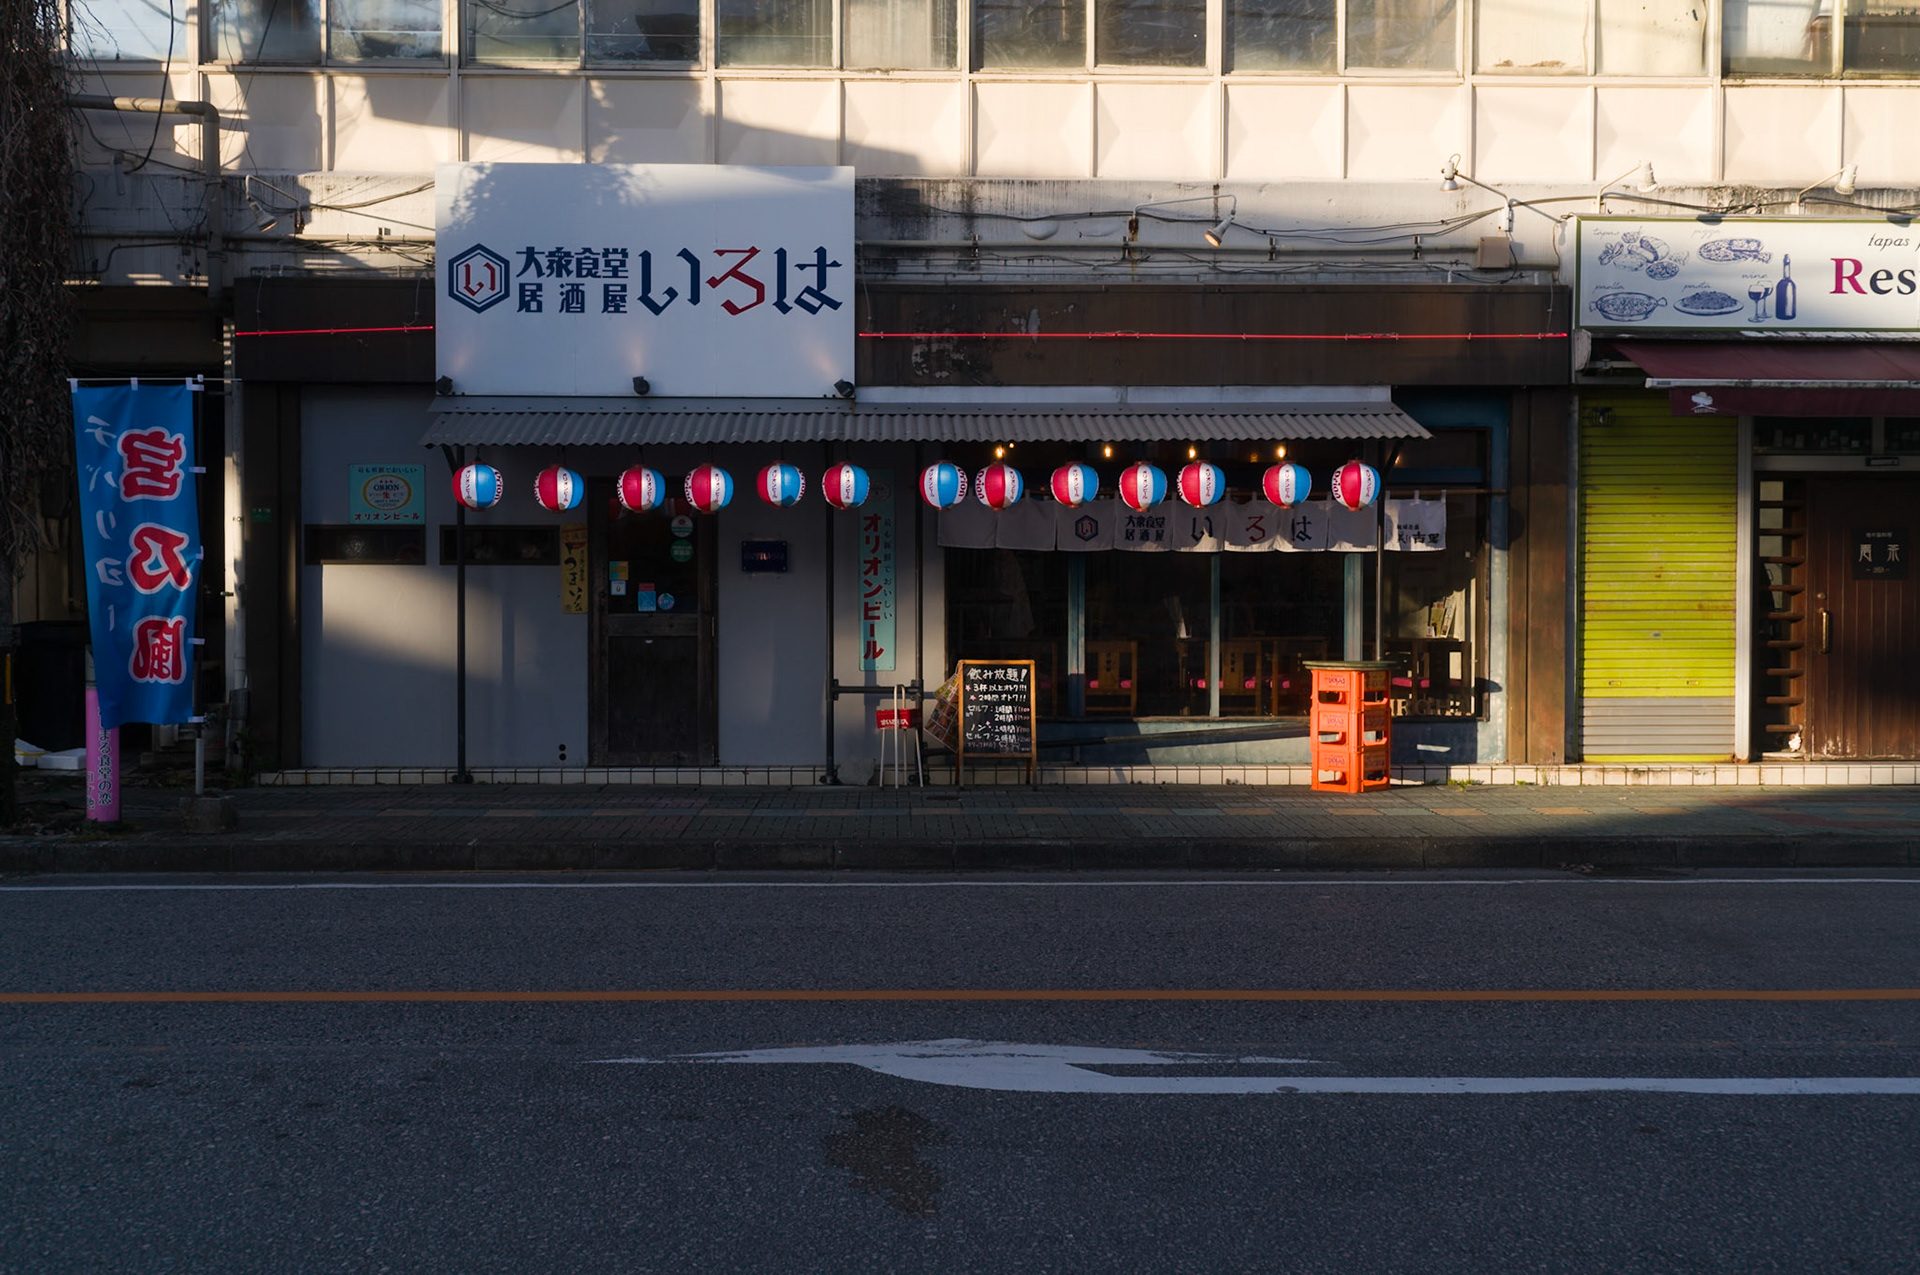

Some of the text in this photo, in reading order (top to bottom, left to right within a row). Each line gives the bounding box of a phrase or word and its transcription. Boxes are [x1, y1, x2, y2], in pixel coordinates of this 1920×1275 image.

[1868, 233, 1910, 252] tapas
[516, 246, 629, 279] 大衆食堂
[1829, 257, 1920, 295] Res
[463, 261, 496, 297] い
[637, 245, 843, 316] いろは
[516, 283, 629, 314] 居酒屋
[958, 468, 968, 497] Orion
[976, 470, 985, 499] Orion
[1333, 470, 1341, 499] Orion
[355, 512, 420, 521] オリオンビール
[1080, 518, 1093, 536] い
[1125, 515, 1166, 527] 大衆食堂
[1191, 514, 1312, 542] いろは
[1125, 529, 1164, 541] 居酒屋
[863, 513, 884, 661] オリオンビール
